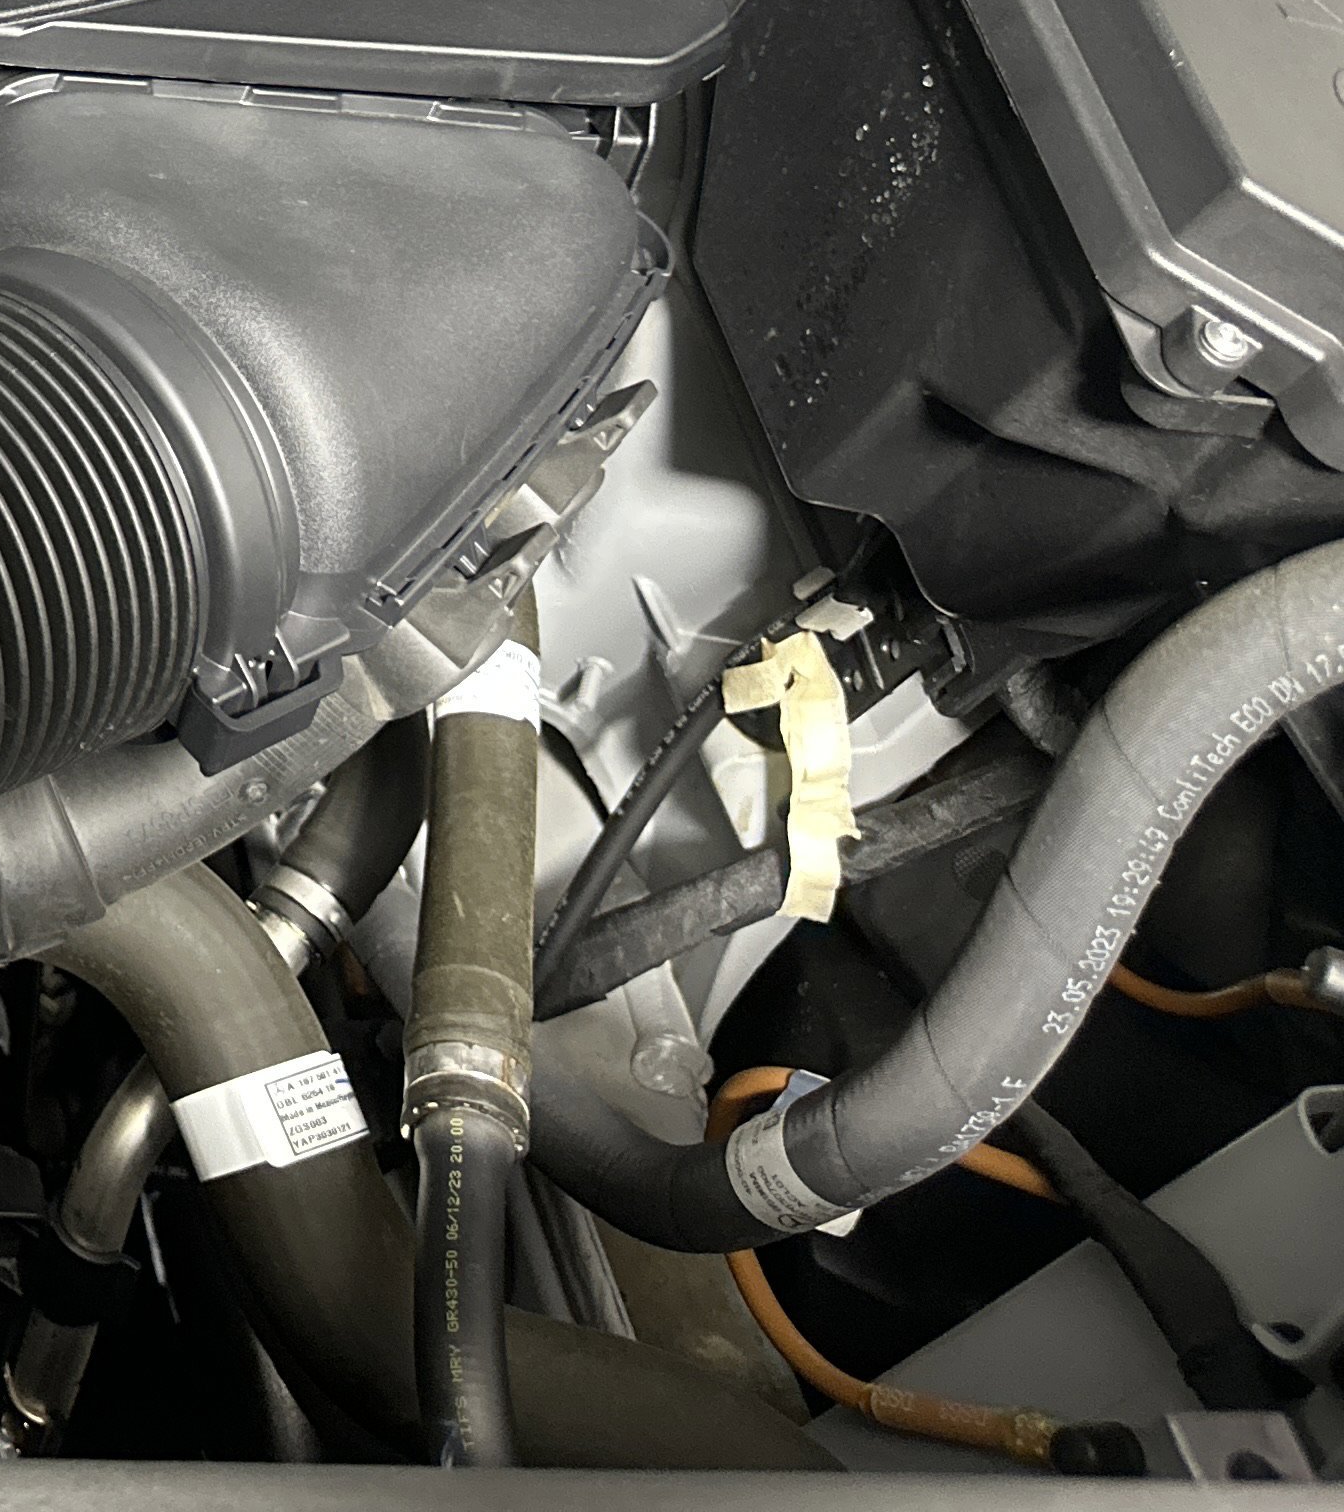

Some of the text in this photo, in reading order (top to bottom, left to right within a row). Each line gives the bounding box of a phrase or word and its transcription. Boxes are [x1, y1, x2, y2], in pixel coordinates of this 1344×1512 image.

[1042, 925, 1121, 1034] 23.05.2023
[1157, 732, 1241, 820] ContiTech
[1229, 696, 1273, 732] ECO
[446, 1170, 462, 1240] 06/12/23
[445, 1250, 459, 1333] GR430-50
[448, 1344, 463, 1383] MRY
